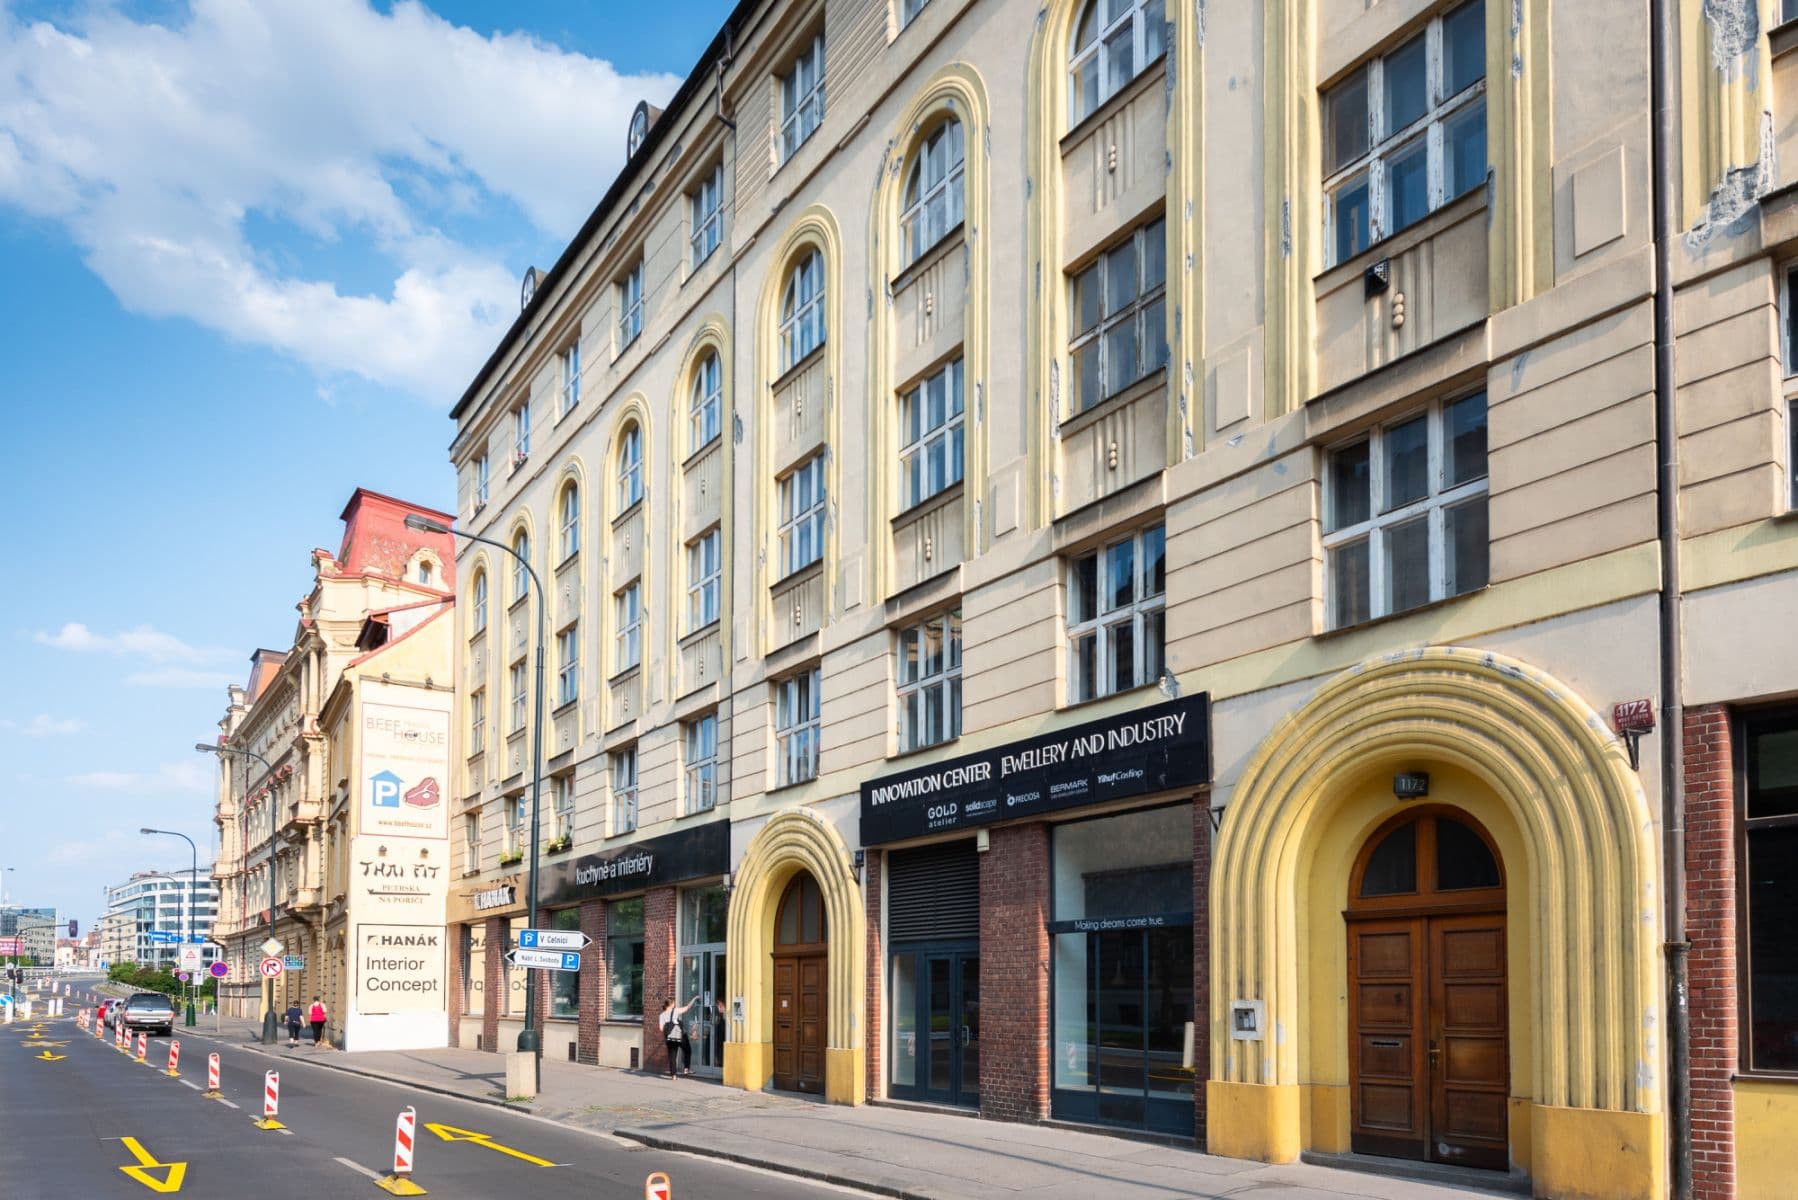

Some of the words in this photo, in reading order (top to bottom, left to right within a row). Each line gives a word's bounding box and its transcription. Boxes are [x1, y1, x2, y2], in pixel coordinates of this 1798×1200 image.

[1618, 700, 1648, 716] 1172
[366, 717, 400, 732] BEEF
[871, 773, 941, 806] INNOVATION
[943, 762, 991, 789] CENTER
[1000, 741, 1068, 779] JEWELLERY
[1071, 734, 1105, 758] AND
[1107, 711, 1186, 752] INDUSTRY
[1050, 779, 1088, 793] BERMARK
[927, 802, 958, 820] GOLD
[928, 817, 957, 828] atelier
[360, 861, 404, 878] THAI
[413, 864, 440, 880] FIT
[610, 864, 616, 878] a
[618, 852, 654, 876] interiéry
[1074, 921, 1099, 930] Making
[1100, 918, 1126, 929] dreams
[1126, 918, 1147, 927] come
[381, 934, 438, 946] HANÁK
[546, 936, 568, 944] Celnici
[366, 956, 425, 970] Interior
[366, 977, 438, 993] Concept
